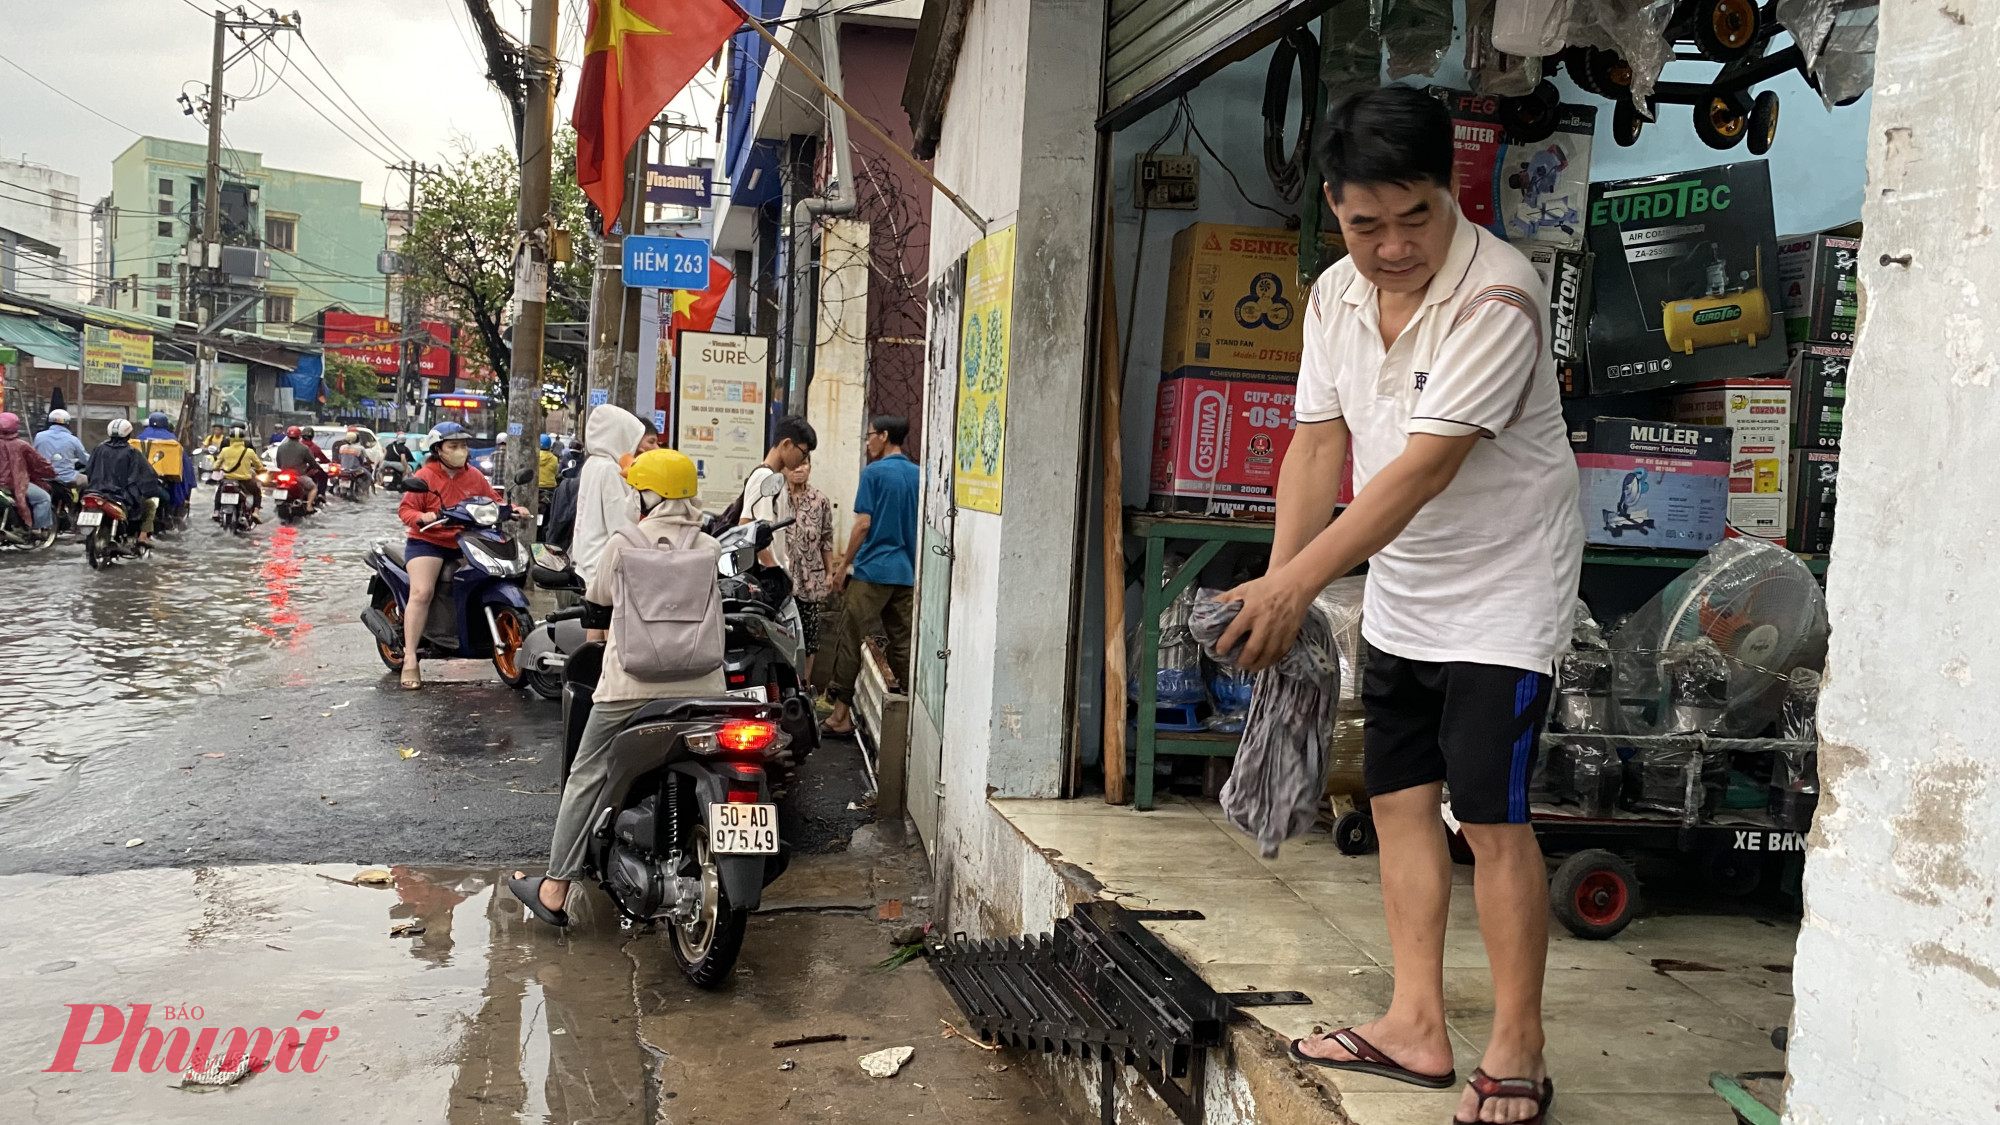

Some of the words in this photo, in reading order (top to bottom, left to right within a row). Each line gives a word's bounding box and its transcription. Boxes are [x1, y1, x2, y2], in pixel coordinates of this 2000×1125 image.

[1458, 96, 1496, 115] FEG
[1454, 125, 1495, 143] MITER
[646, 170, 705, 191] Vinamilk
[1628, 231, 1643, 242] AIR
[633, 246, 669, 272] HẺM
[674, 253, 703, 274] 263
[1553, 261, 1578, 358] DEKTON
[1215, 338, 1238, 347] STAND
[1239, 339, 1254, 348] FAN
[103, 361, 120, 369] INOX
[701, 348, 747, 365] SURE
[1209, 370, 1240, 379] ACHIEVED
[1241, 372, 1265, 380] POWER
[1266, 373, 1292, 382] SAVING
[1198, 402, 1217, 468] OSHIMA
[1630, 425, 1700, 445] MULER
[1629, 443, 1660, 452] Germany
[1661, 445, 1698, 455] Technology
[1205, 482, 1232, 492] PWER
[1240, 485, 1268, 495] 2000W
[720, 806, 768, 828] 50-AD
[716, 829, 774, 851] 975.49
[1733, 830, 1761, 851] XE
